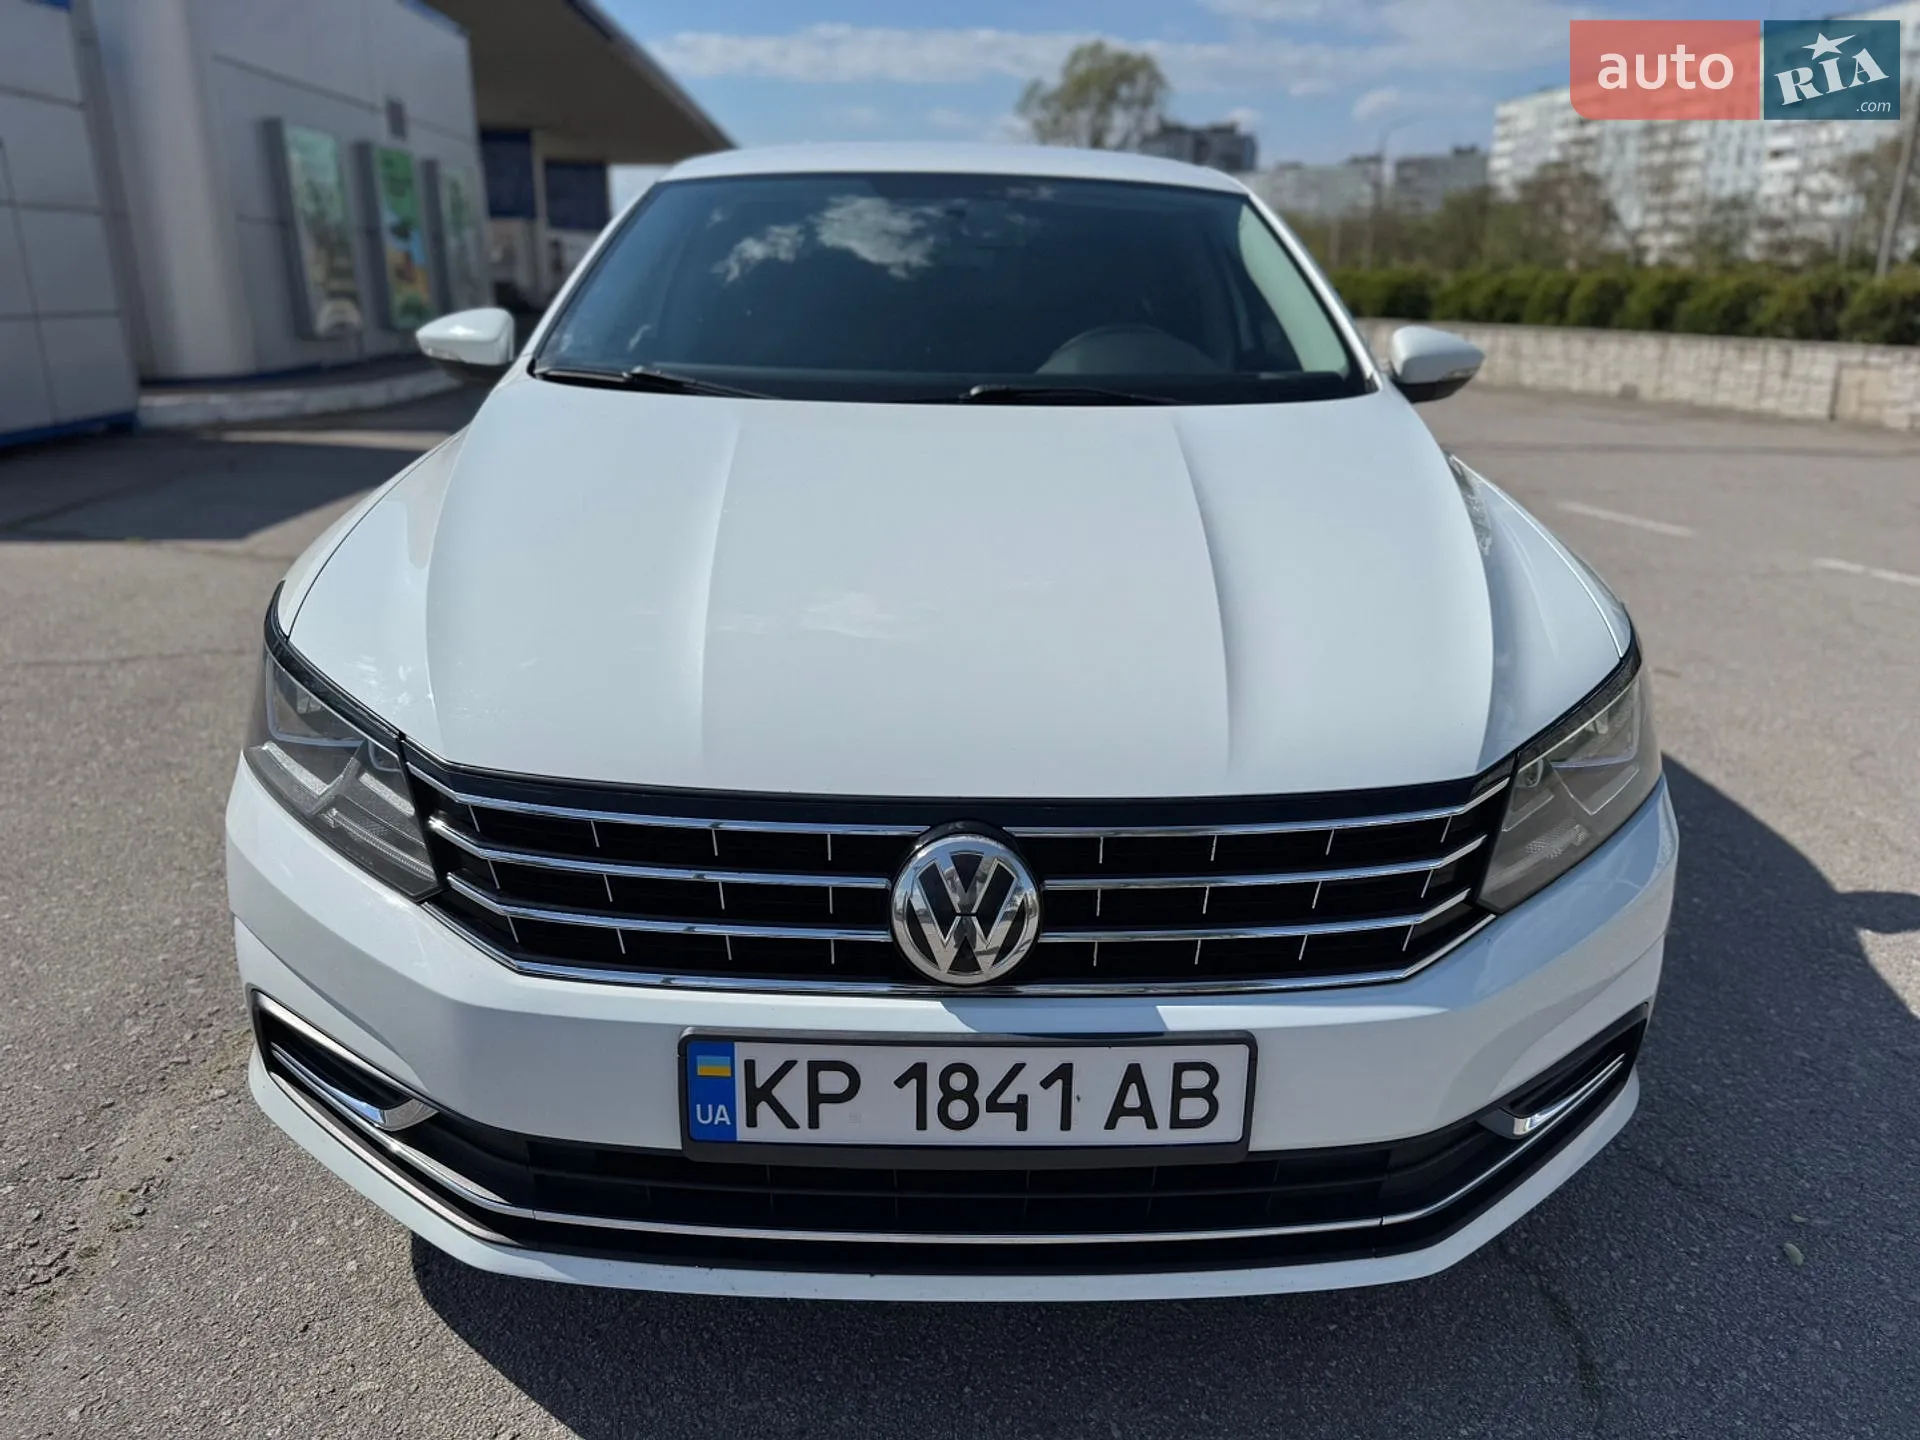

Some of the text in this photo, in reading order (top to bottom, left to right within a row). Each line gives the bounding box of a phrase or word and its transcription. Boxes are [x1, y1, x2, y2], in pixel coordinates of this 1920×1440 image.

[696, 1104, 731, 1126] UA
[744, 1059, 1219, 1132] KP 1841 AB
